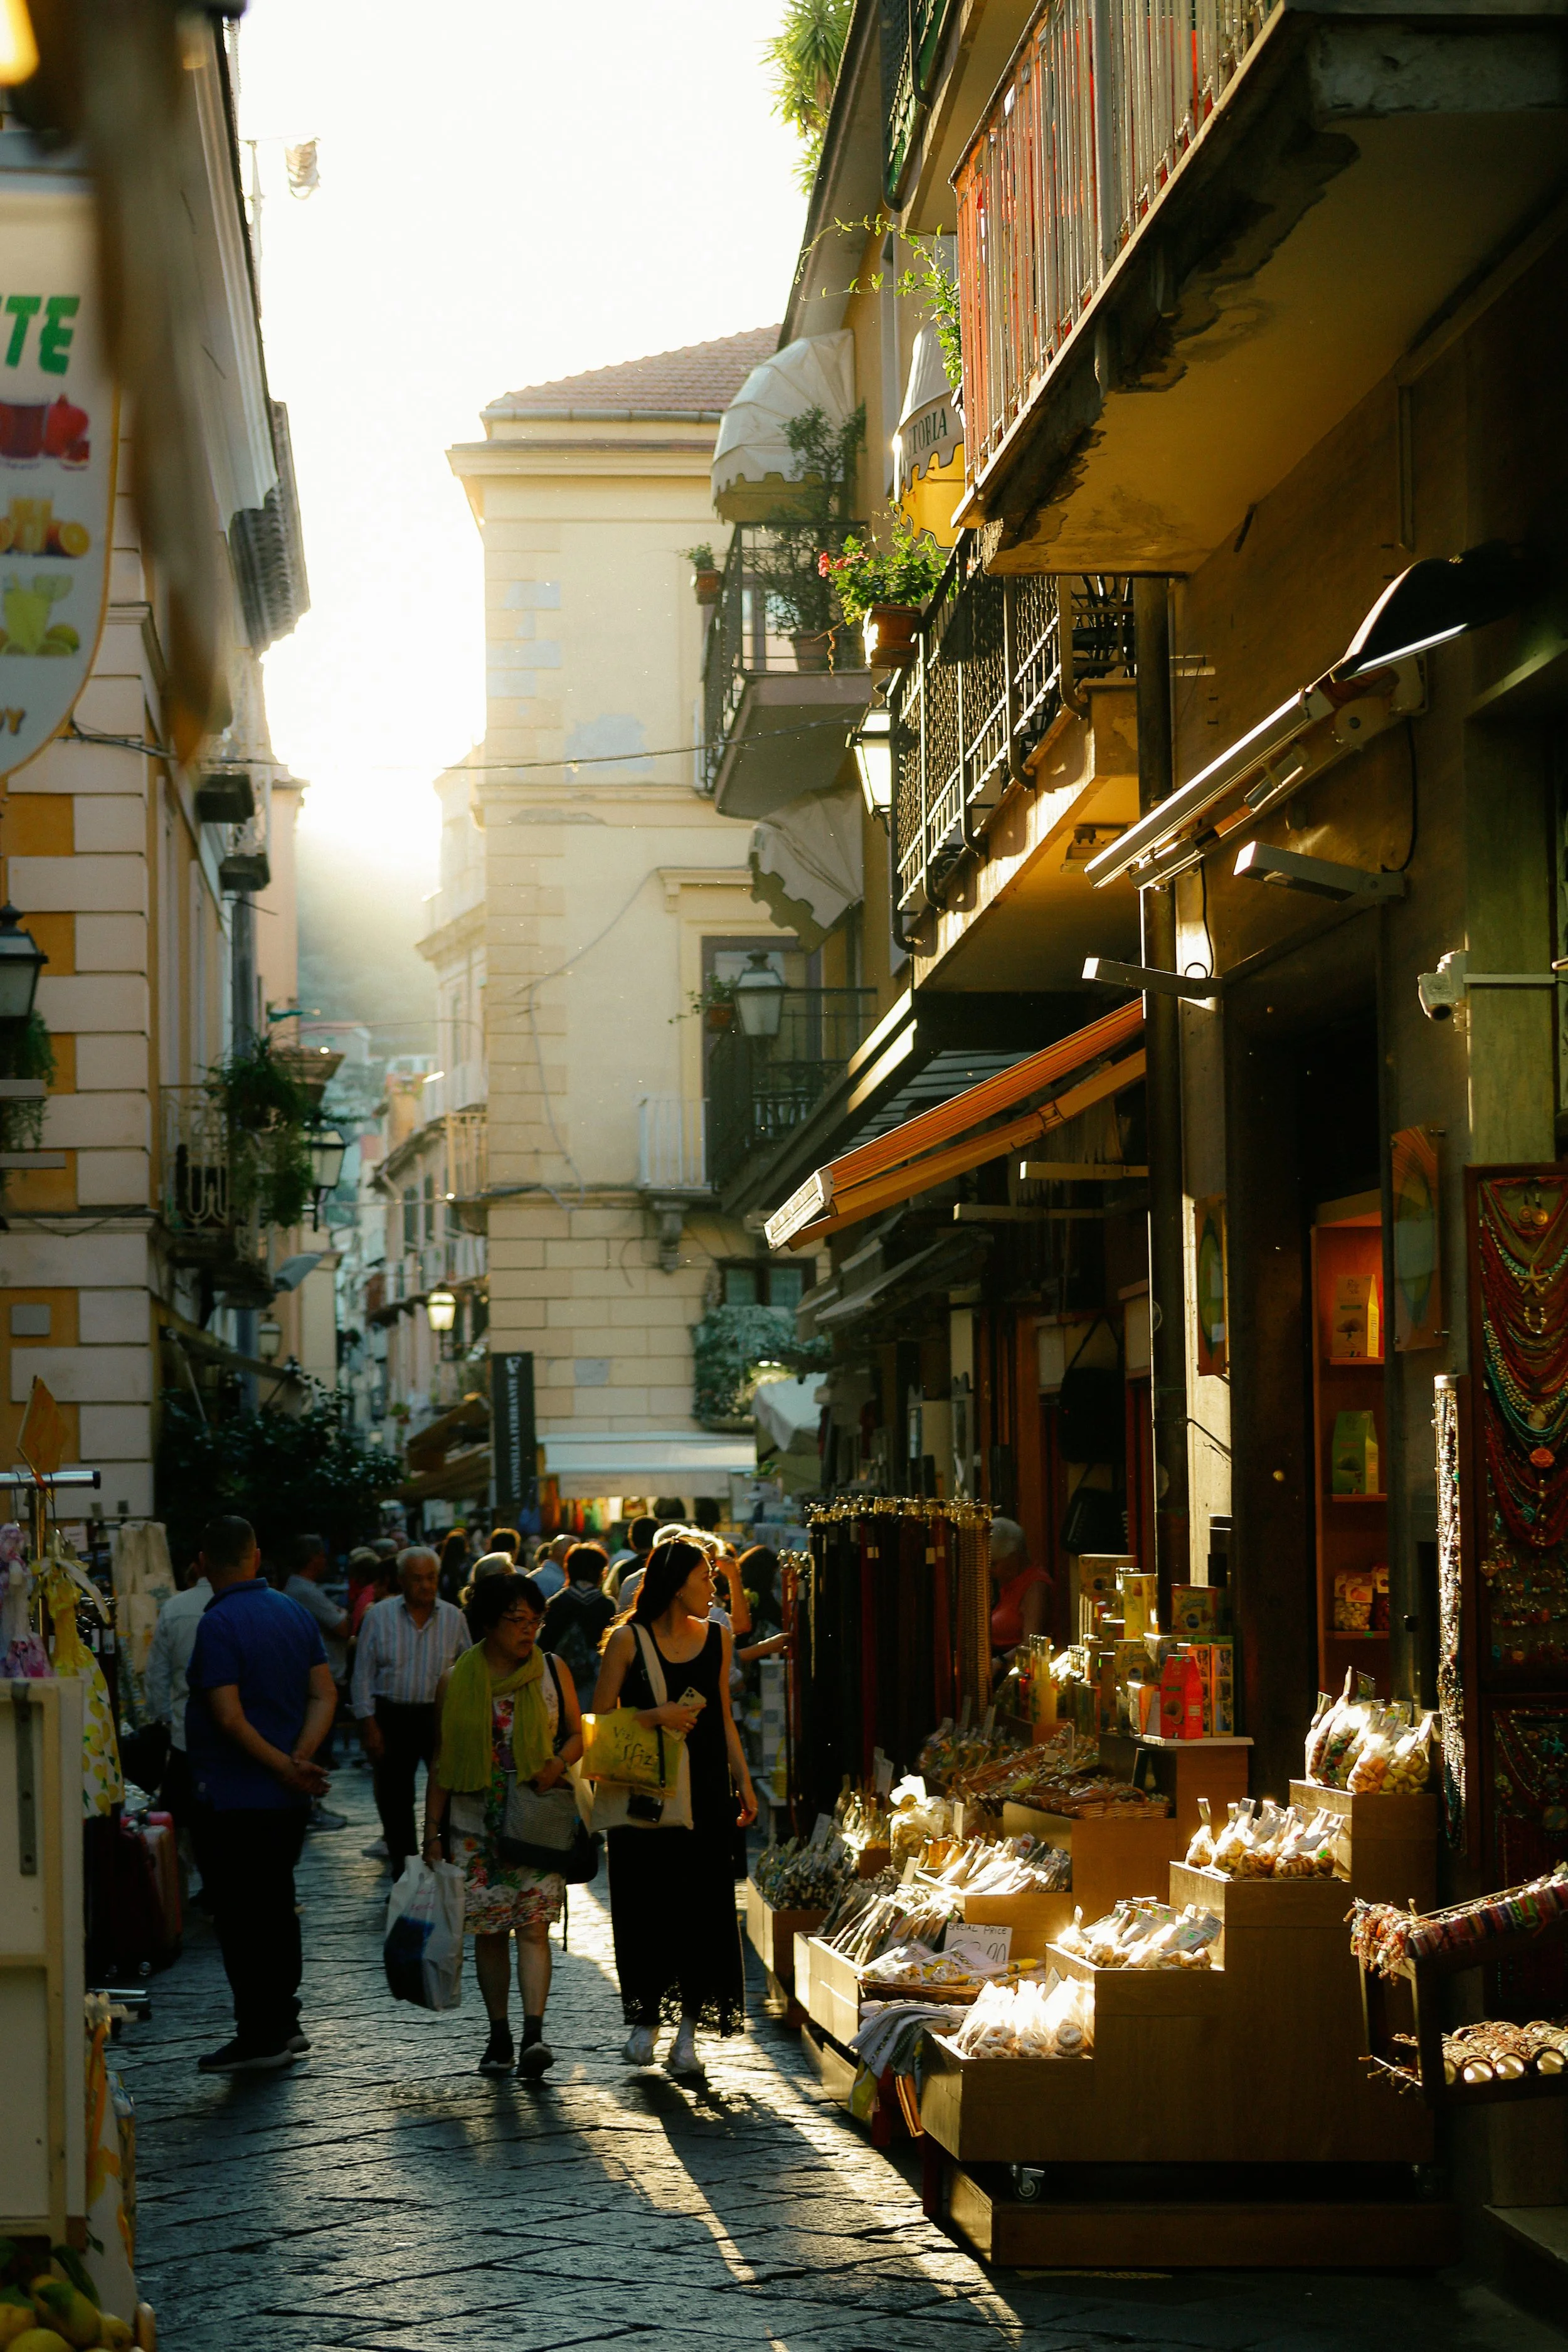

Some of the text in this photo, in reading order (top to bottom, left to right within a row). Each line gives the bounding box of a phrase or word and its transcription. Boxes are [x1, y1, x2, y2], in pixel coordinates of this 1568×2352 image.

[0, 295, 80, 375] TE
[619, 1743, 659, 1770] Sfiz
[947, 1924, 1007, 1935] SPECIAL PRICE
